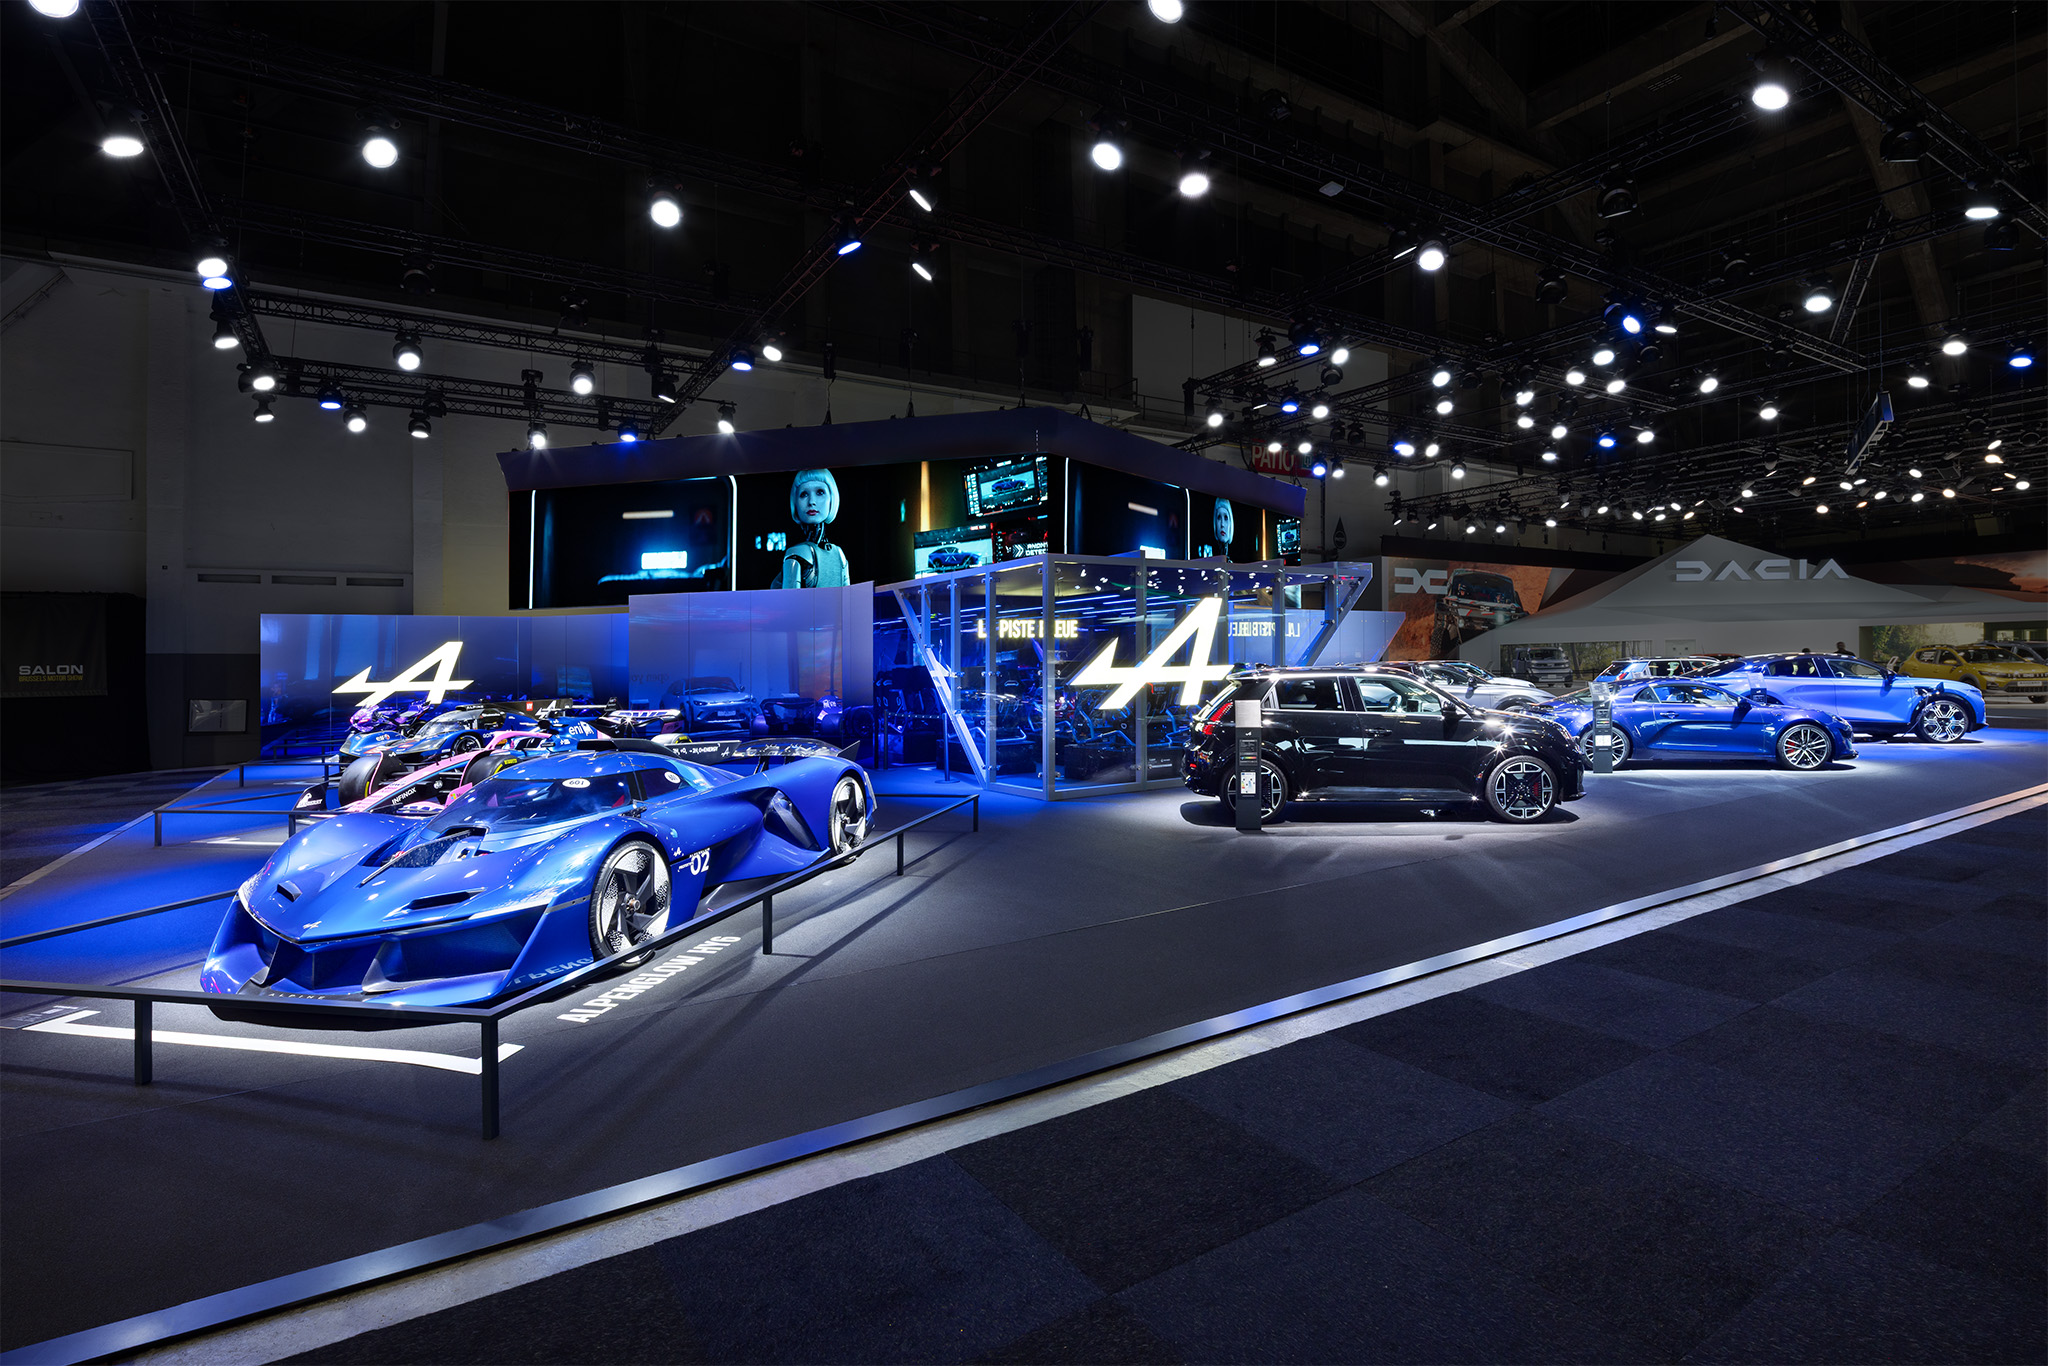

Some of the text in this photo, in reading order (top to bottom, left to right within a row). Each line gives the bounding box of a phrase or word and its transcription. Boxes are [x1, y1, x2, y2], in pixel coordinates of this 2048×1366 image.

[1025, 548, 1048, 557] DETEC
[1675, 558, 1850, 583] DACIA
[999, 619, 1036, 639] PISTE
[18, 664, 84, 675] SALON
[47, 674, 67, 682] MOTOR
[568, 721, 584, 735] eni
[391, 787, 417, 805] INFINOX
[556, 936, 741, 1024] ALPENGLOW HY6
